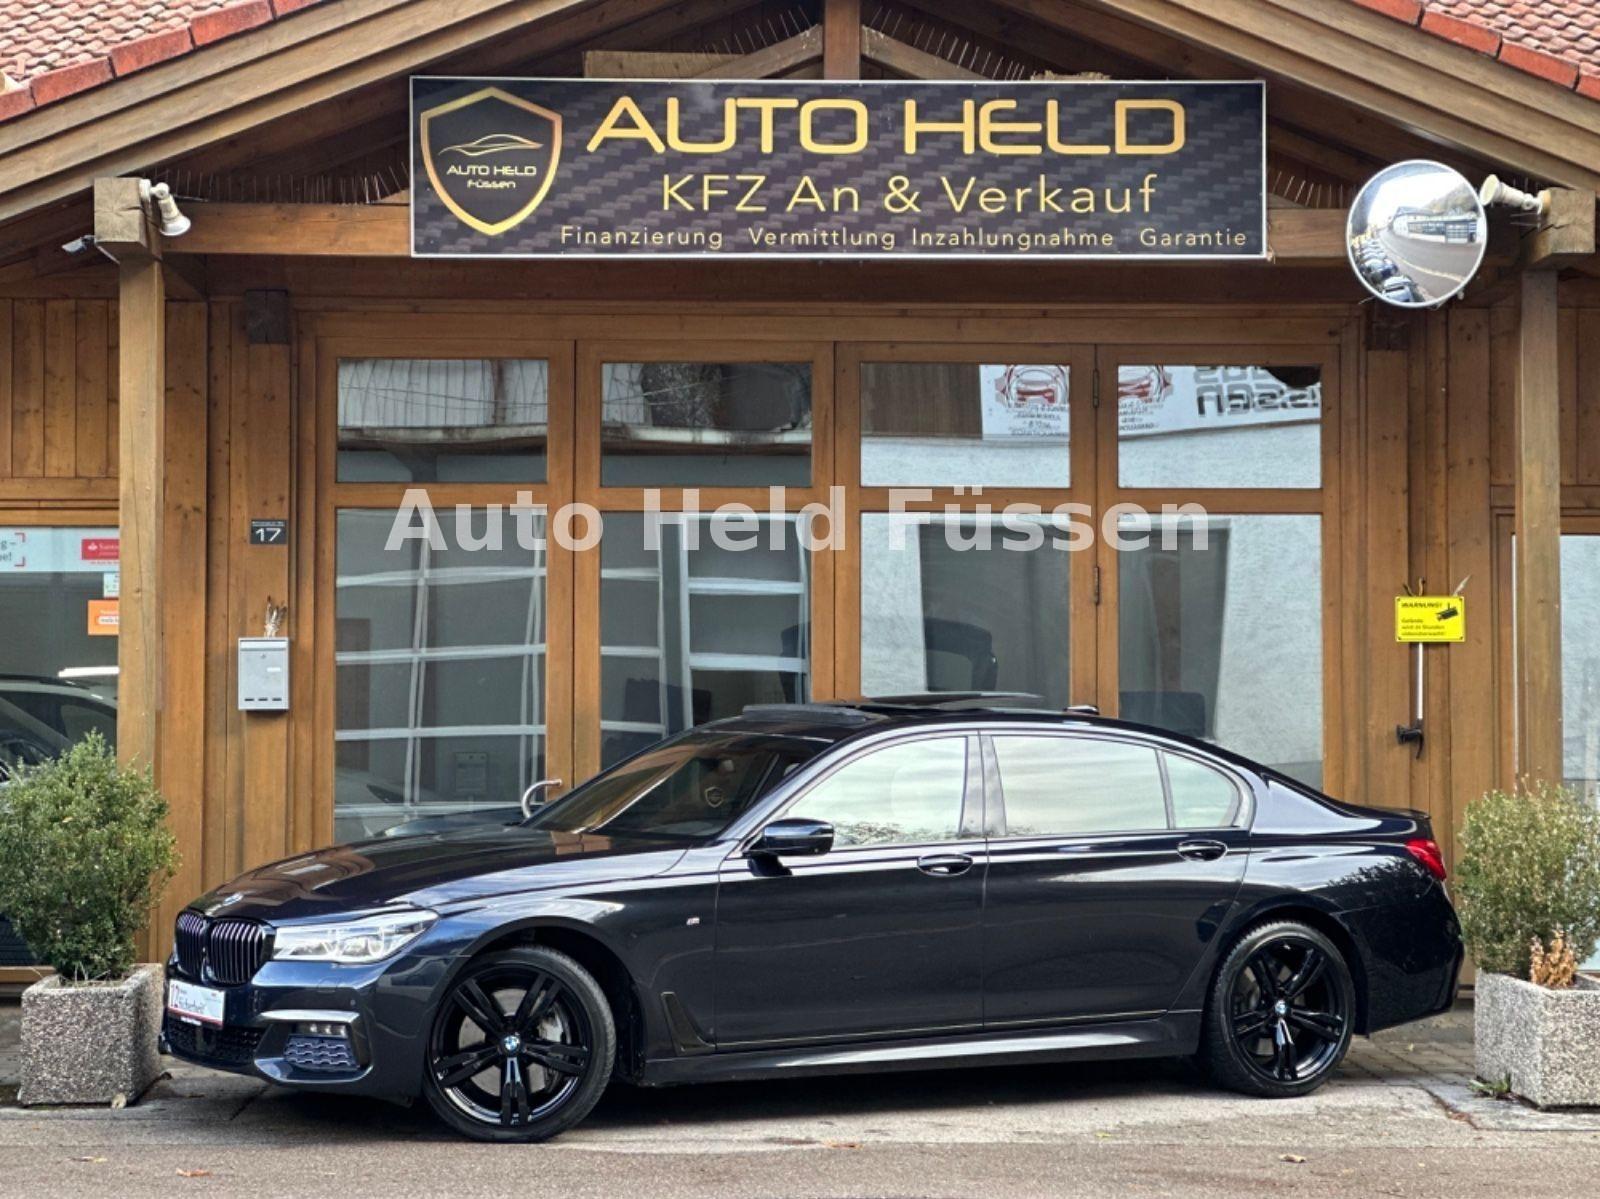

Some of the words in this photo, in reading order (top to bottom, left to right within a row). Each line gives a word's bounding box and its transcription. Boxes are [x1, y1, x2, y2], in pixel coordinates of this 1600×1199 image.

[586, 95, 869, 155] AUTO
[904, 98, 1186, 155] HELD
[447, 164, 490, 176] AUTO
[493, 165, 537, 176] HELD
[662, 173, 767, 212] KFZ
[786, 175, 859, 212] An
[883, 175, 921, 213] &
[940, 173, 1158, 213] Verkauf
[561, 225, 723, 249] Finanzierung
[748, 226, 895, 250] Vermittlung
[912, 227, 1114, 251] Inzahlungnahme
[1140, 227, 1247, 248] Garantie
[255, 527, 281, 542] 17
